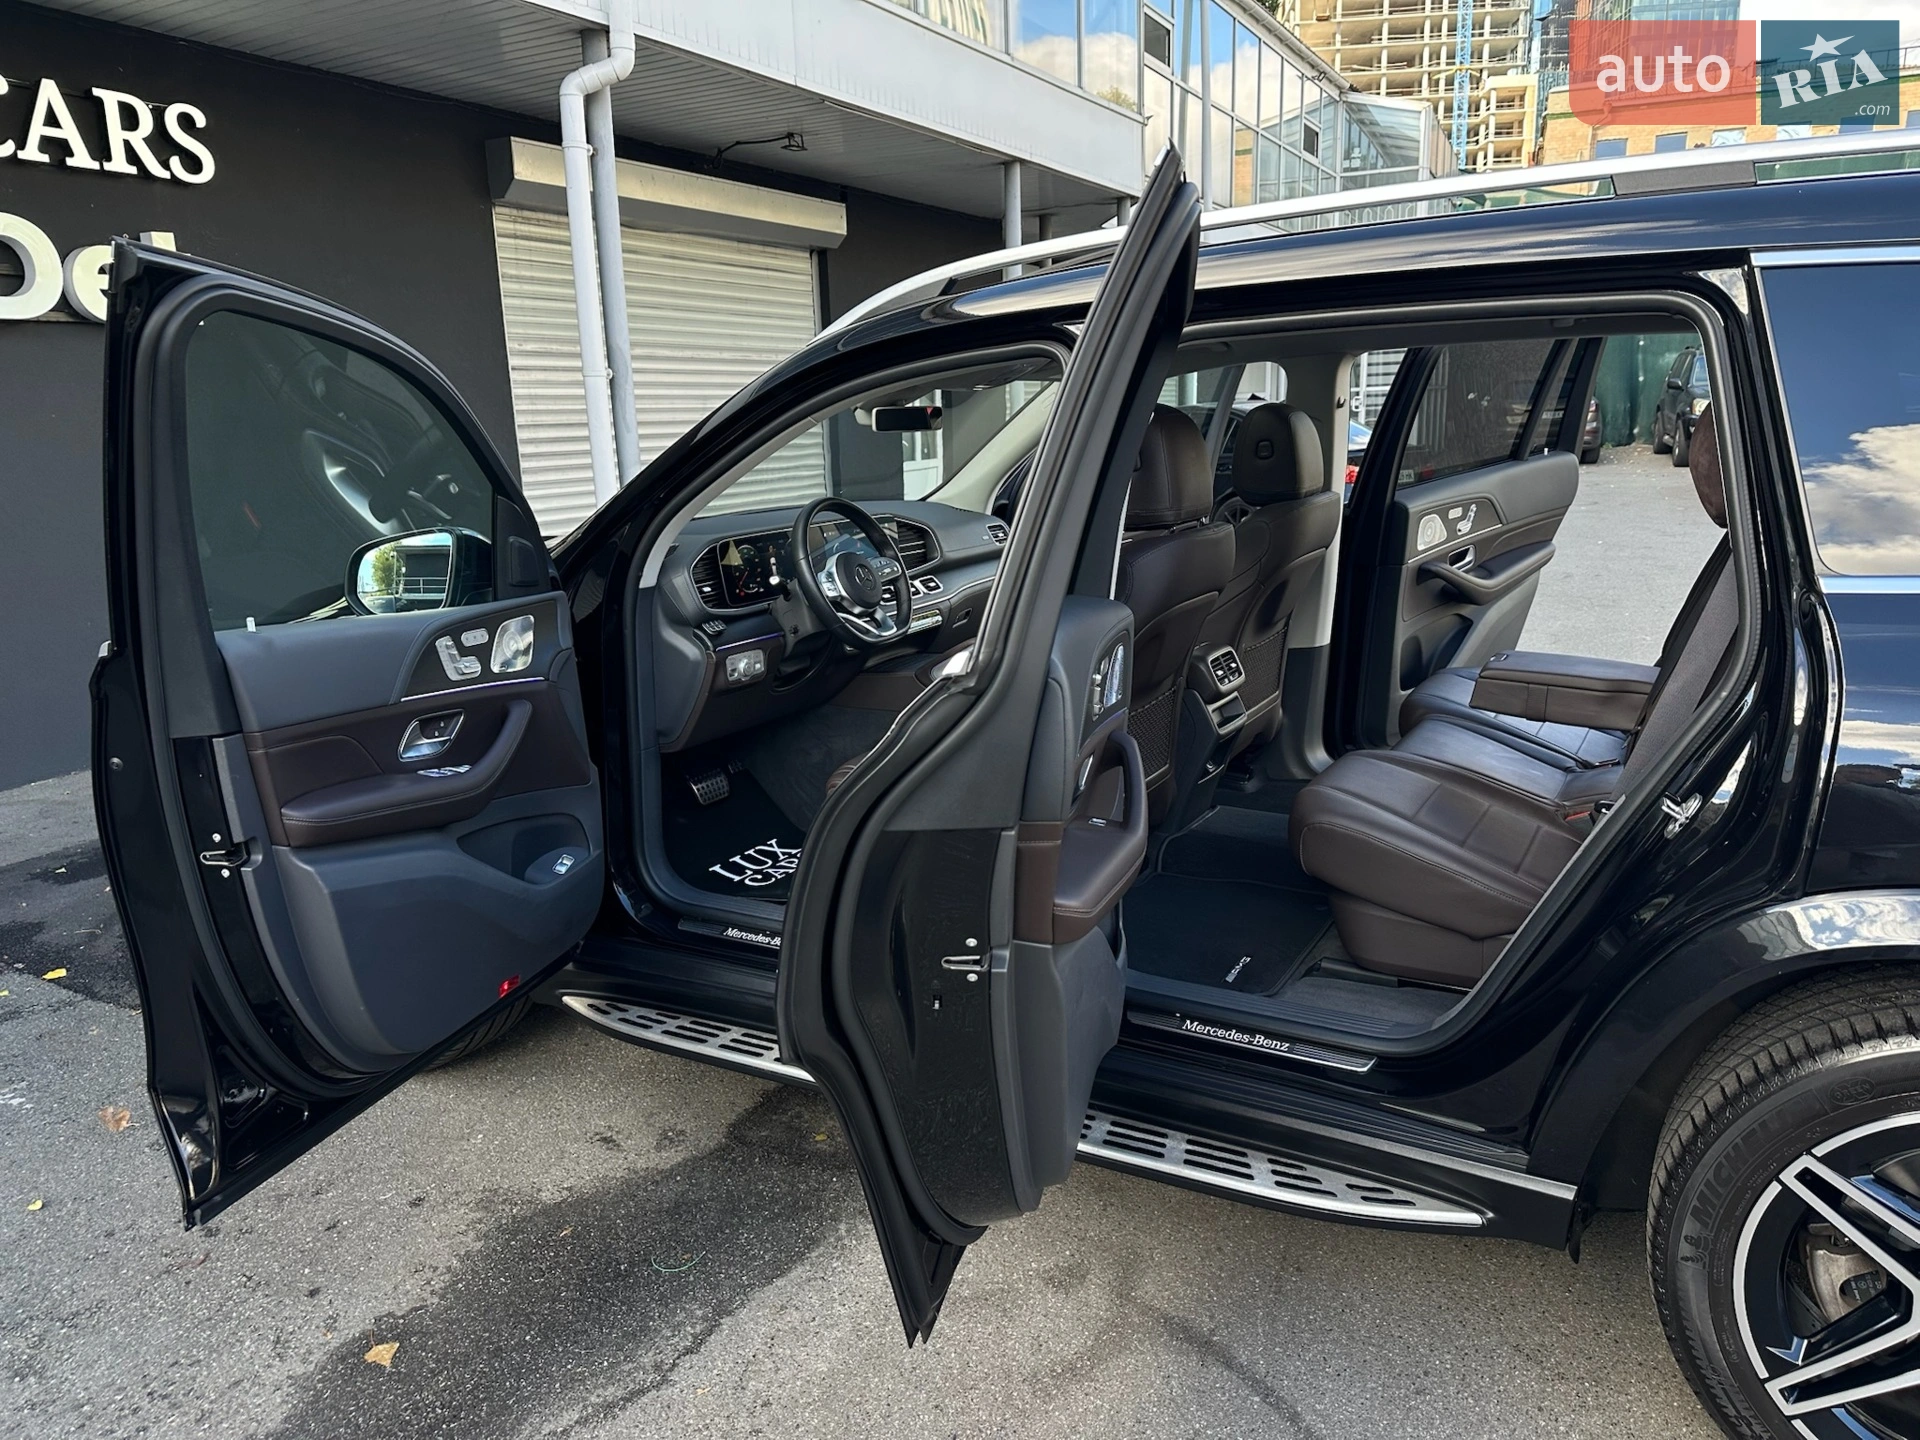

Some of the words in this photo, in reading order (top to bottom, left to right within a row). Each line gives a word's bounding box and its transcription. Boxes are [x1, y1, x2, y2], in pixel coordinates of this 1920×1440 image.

[0, 211, 177, 324] De
[709, 838, 802, 882] LUX
[744, 853, 801, 887] CAR
[1182, 1019, 1291, 1052] Mercedes-Benz
[1690, 1094, 1812, 1229] MICHELI
